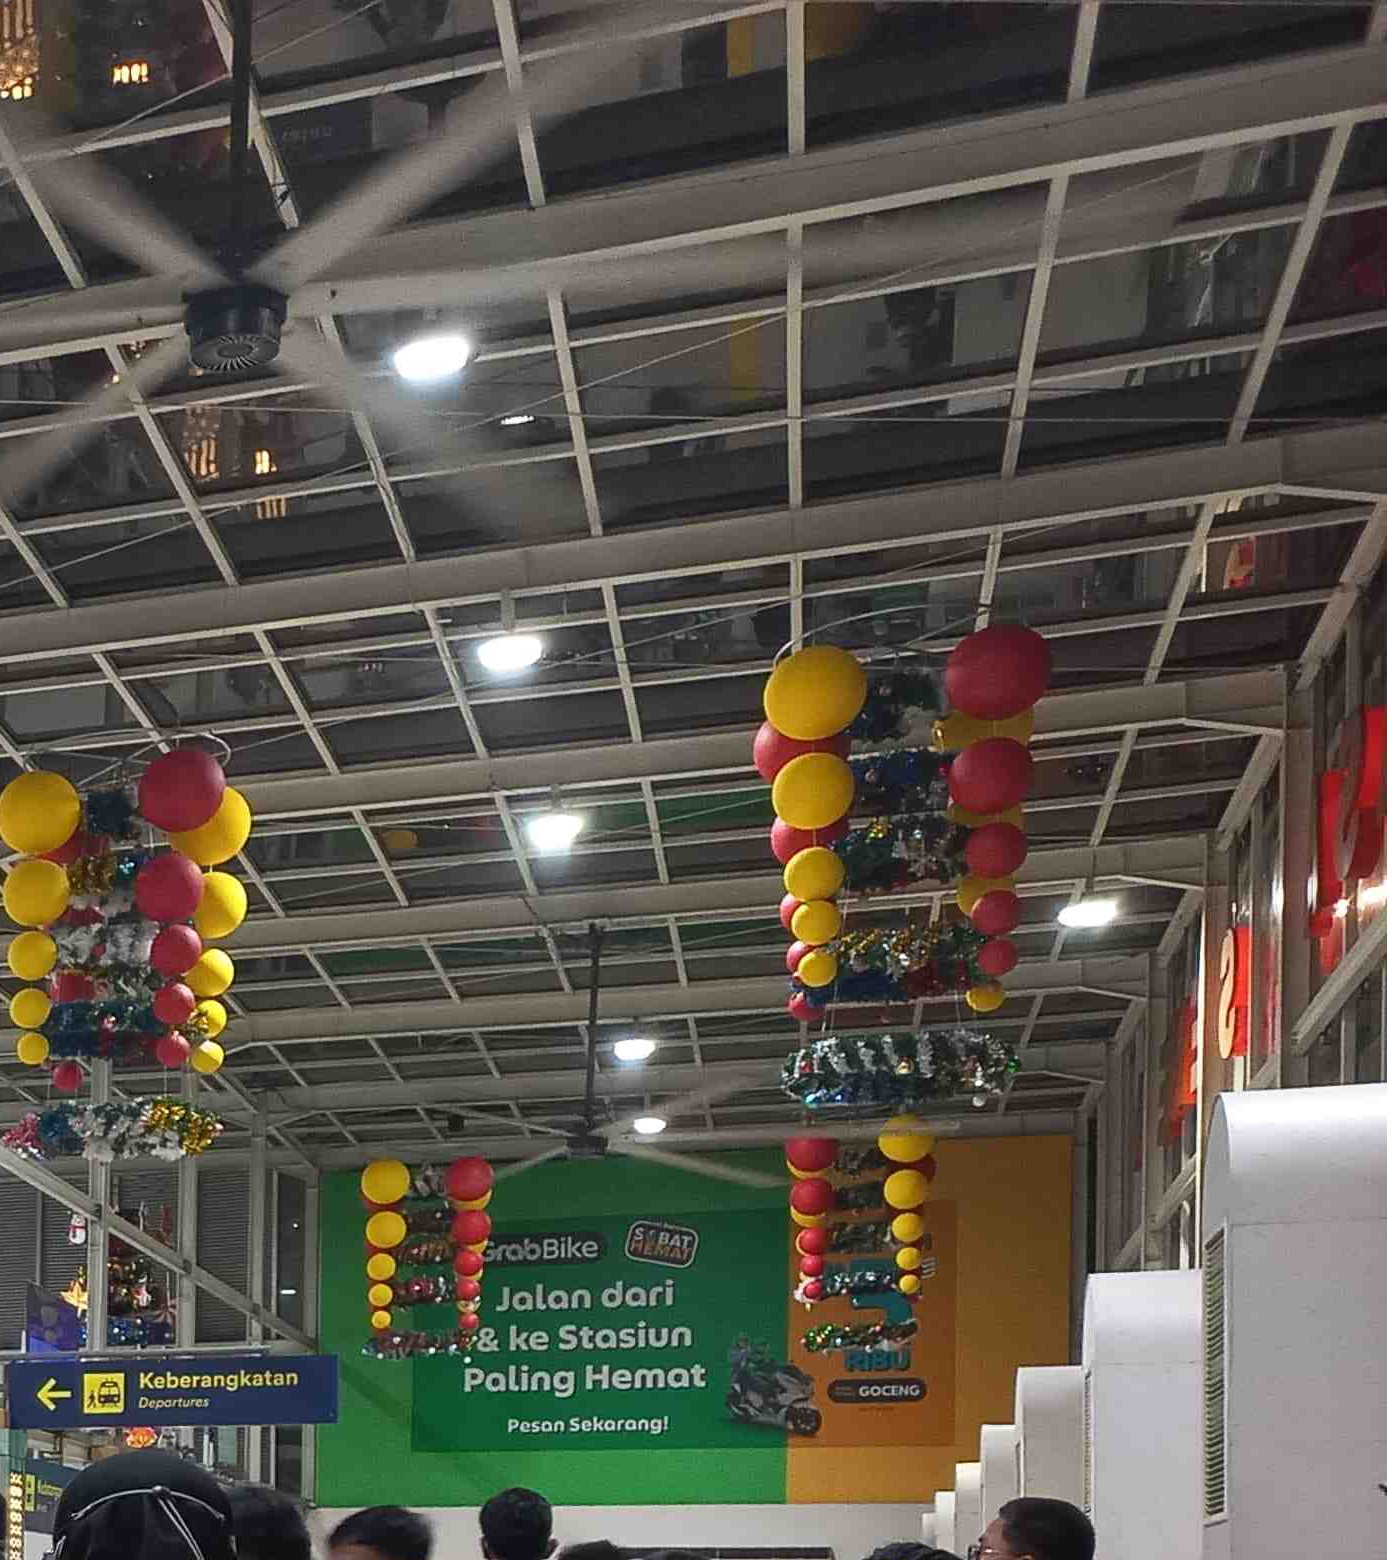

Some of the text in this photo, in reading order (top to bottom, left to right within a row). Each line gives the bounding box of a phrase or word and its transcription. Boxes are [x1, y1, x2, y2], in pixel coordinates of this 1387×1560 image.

[496, 1279, 675, 1311] Jalan dari
[477, 1321, 693, 1352] & ke Stasiun
[138, 1369, 299, 1391] Keberangkatan
[463, 1363, 707, 1398] Paling Hemat
[858, 1385, 921, 1397] GOCENG
[138, 1396, 210, 1410] Departures
[507, 1416, 669, 1434] Pesan Sekarang!
